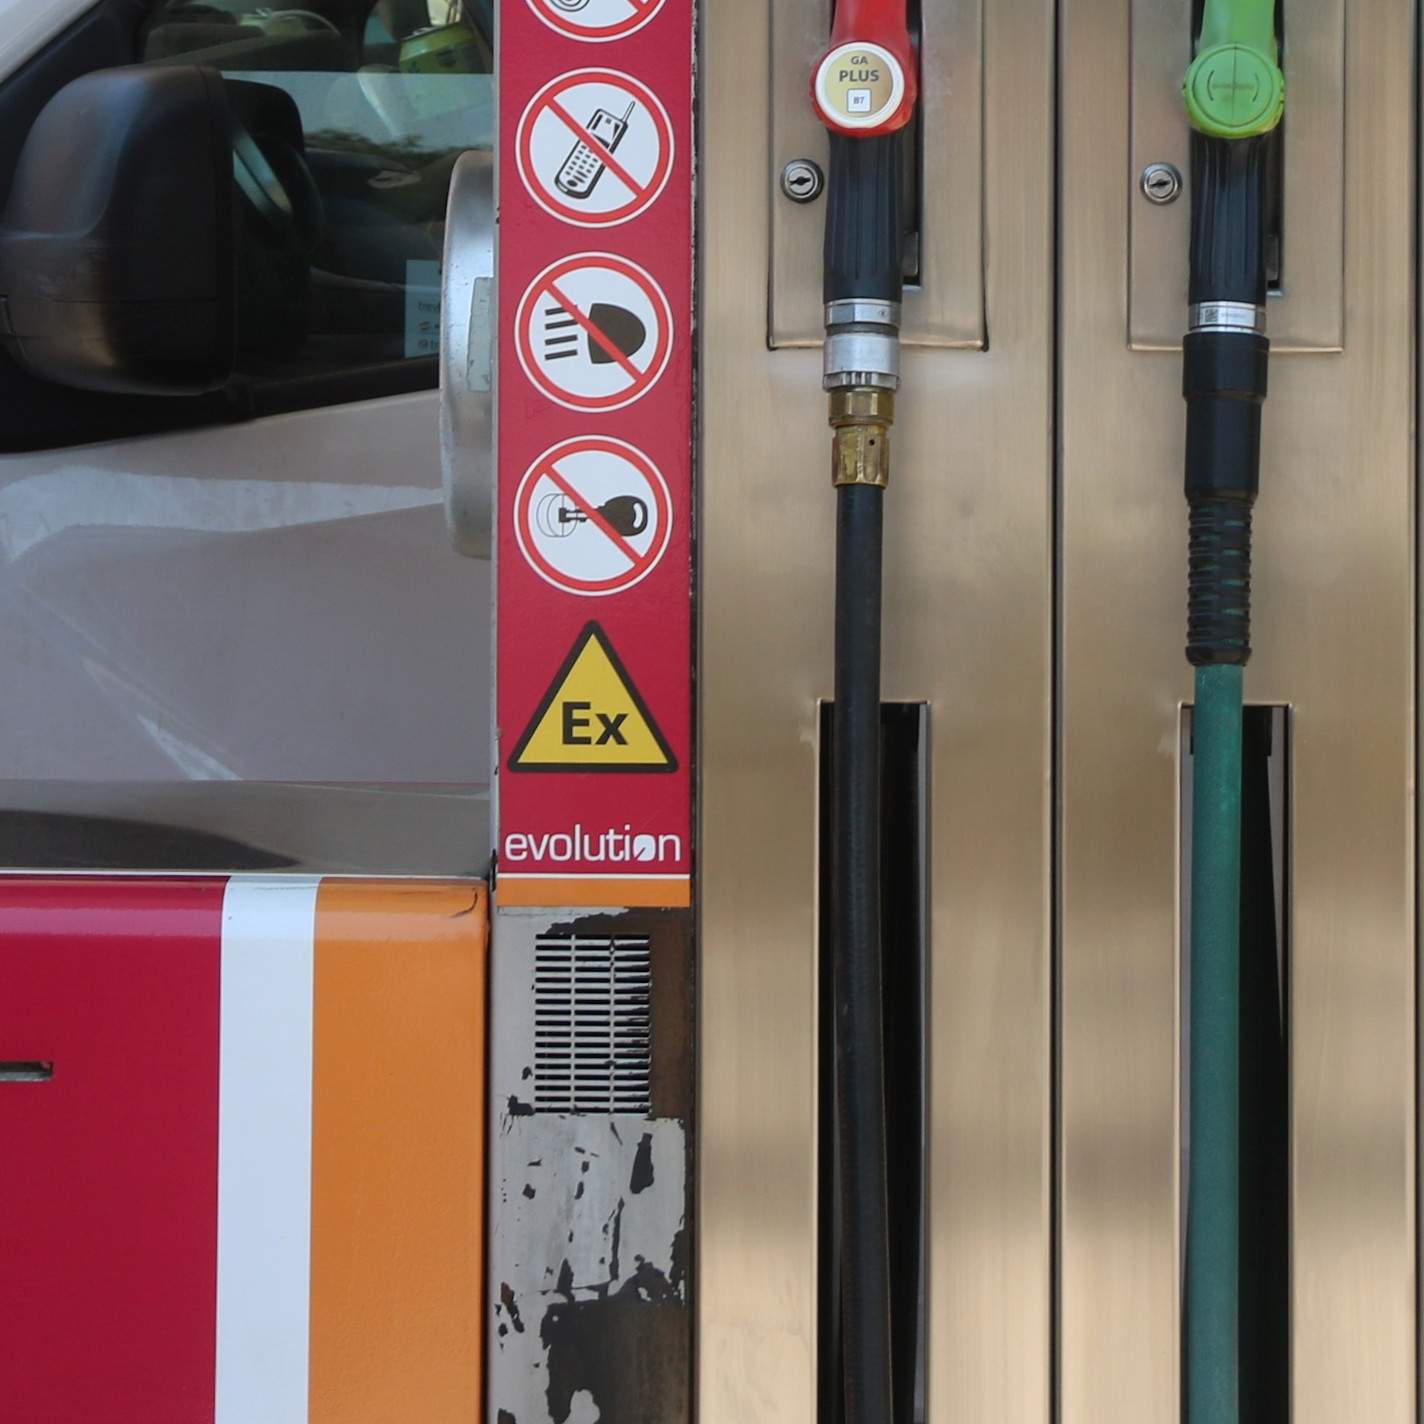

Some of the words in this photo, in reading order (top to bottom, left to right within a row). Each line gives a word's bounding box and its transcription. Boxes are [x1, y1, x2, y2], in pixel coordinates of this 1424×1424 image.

[850, 56, 869, 65] GA
[839, 70, 880, 82] PLUS
[562, 701, 629, 745] Ex
[504, 823, 682, 862] evolution
